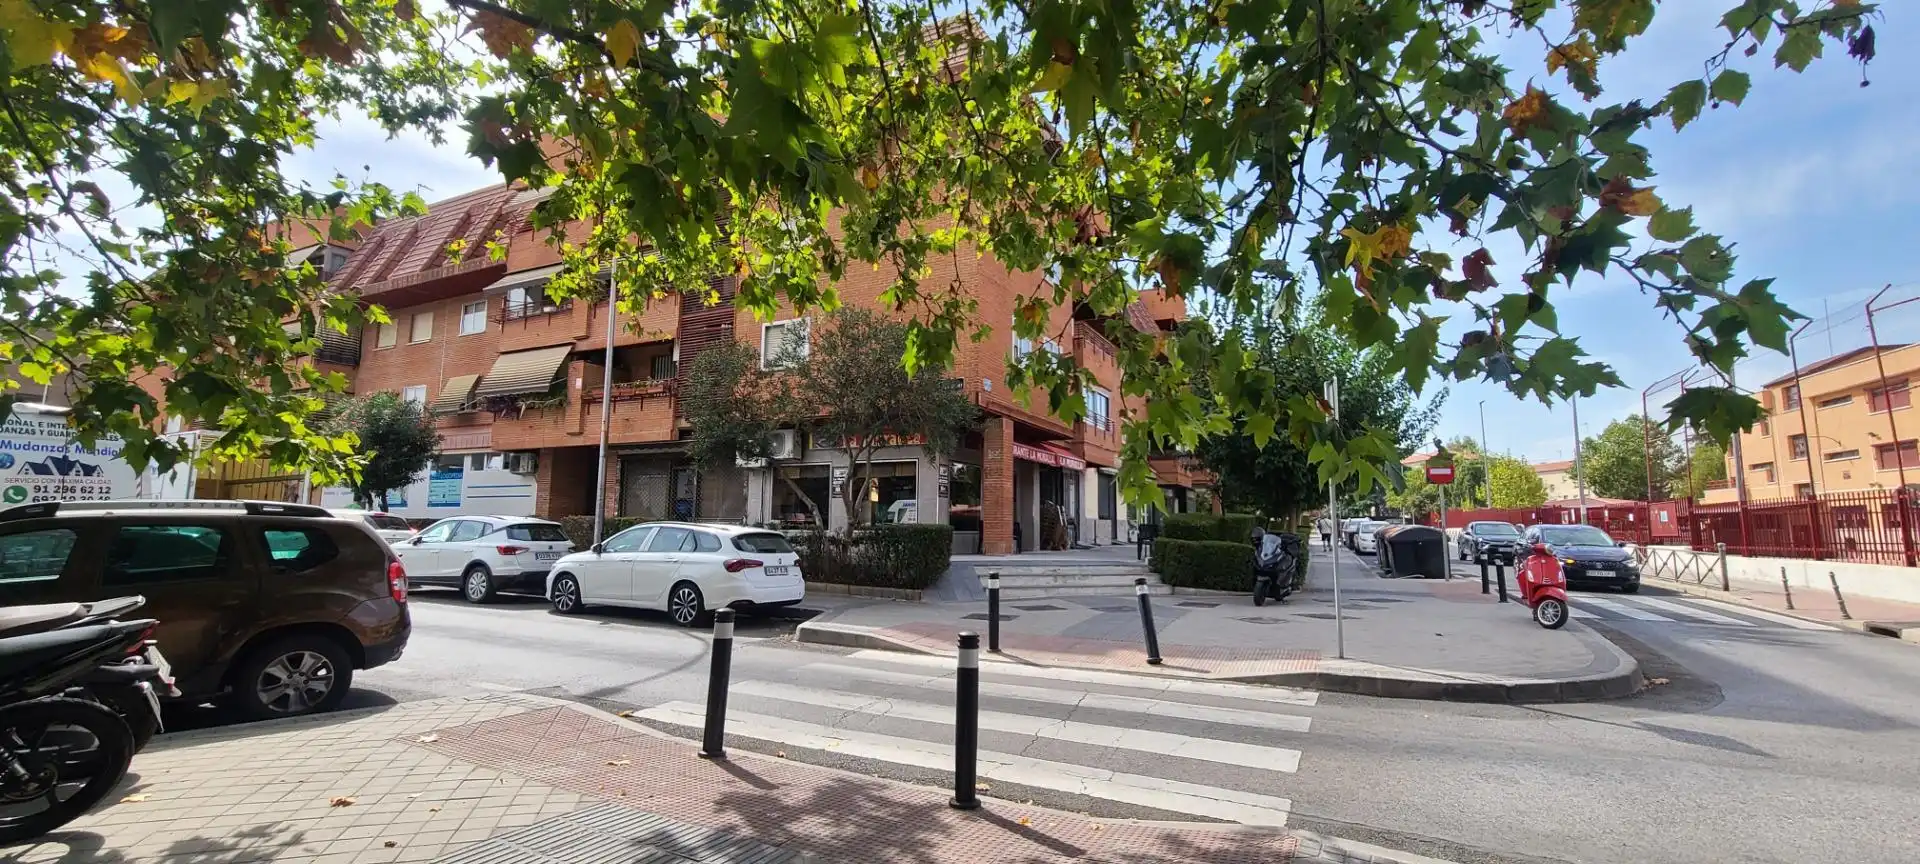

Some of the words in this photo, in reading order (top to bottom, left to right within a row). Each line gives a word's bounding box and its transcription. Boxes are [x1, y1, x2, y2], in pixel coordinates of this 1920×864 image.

[33, 485, 49, 493] 91
[53, 485, 77, 494] 296
[80, 486, 94, 494] 62
[98, 486, 112, 494] 12
